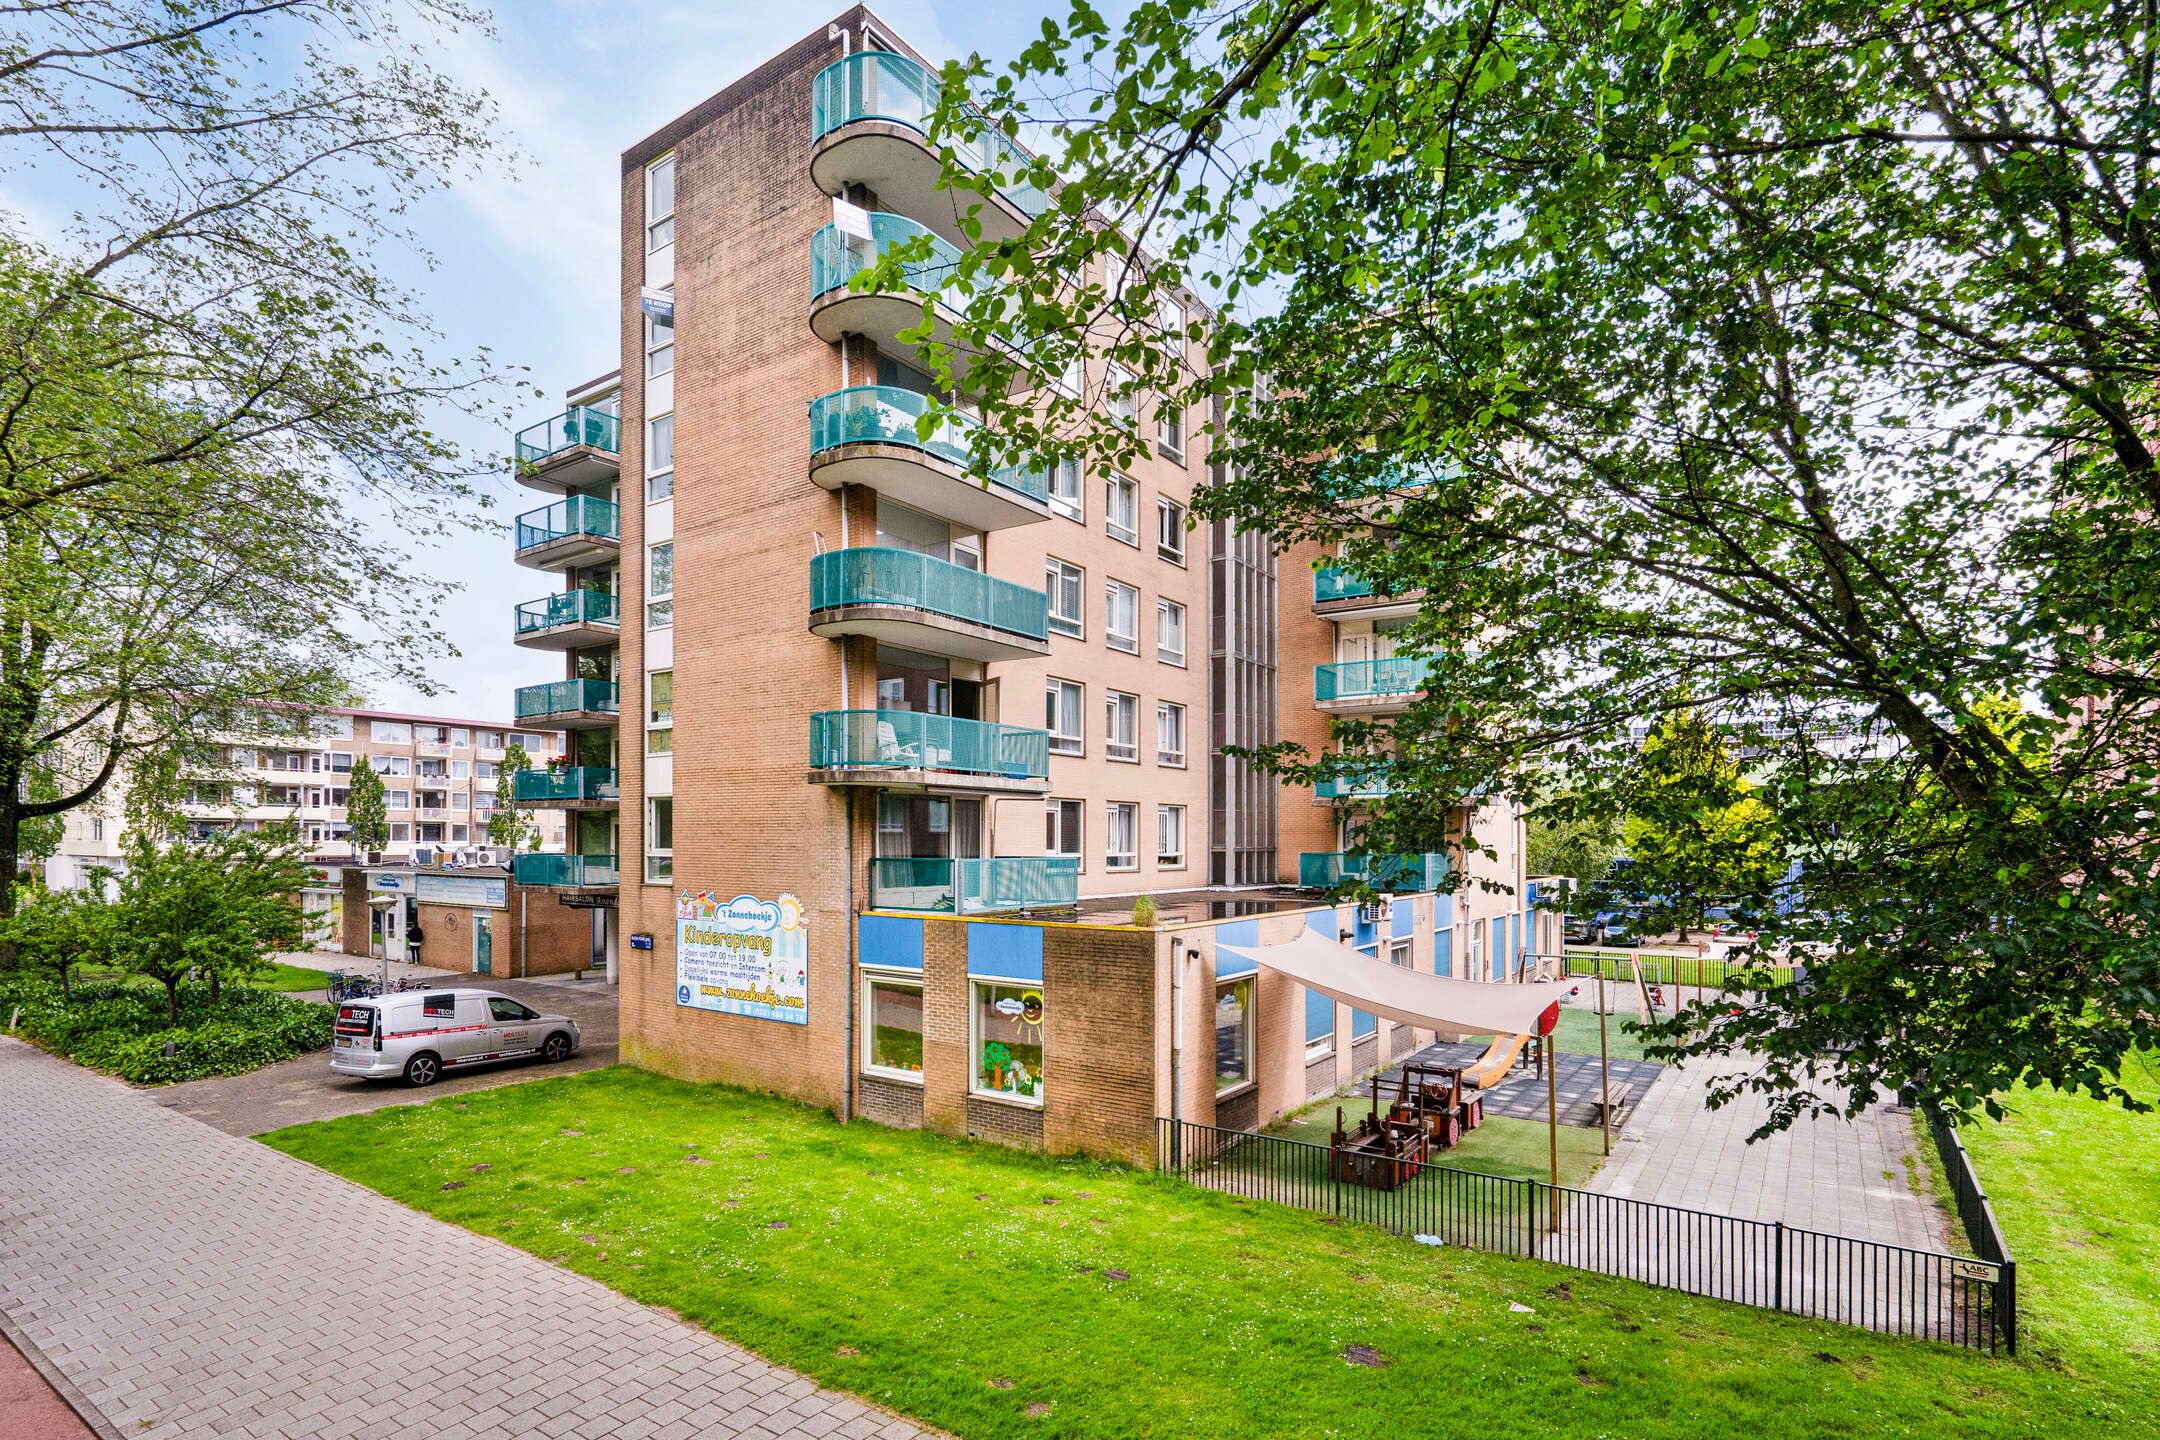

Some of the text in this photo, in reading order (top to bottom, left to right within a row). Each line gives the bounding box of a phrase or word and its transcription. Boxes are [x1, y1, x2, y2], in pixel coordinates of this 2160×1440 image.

[562, 894, 594, 903] HAIRSALON
[684, 924, 773, 957] Kinderopvang
[684, 949, 698, 958] Open
[709, 951, 727, 960] 07.00
[738, 954, 757, 963] 19.00
[684, 956, 705, 966] Camera
[706, 960, 730, 969] toezicht
[739, 963, 766, 973] Intercom
[684, 972, 709, 983] Flexibele
[709, 969, 729, 977] warme
[729, 971, 761, 982] maaltijden
[1969, 1265, 1989, 1274] ABC
